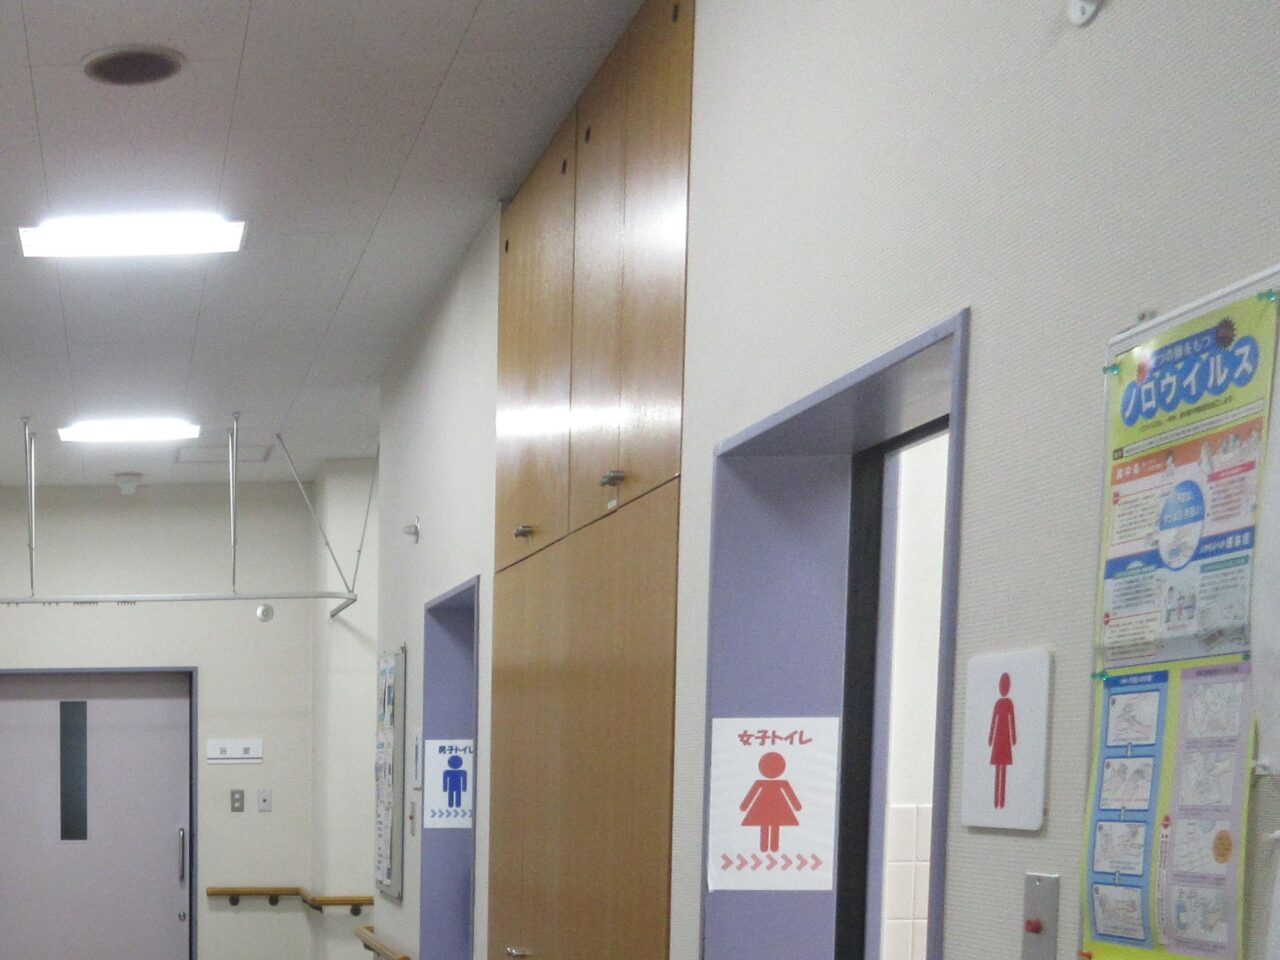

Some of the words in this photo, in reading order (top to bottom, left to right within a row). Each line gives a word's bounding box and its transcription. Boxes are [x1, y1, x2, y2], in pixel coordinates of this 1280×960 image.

[1124, 344, 1252, 419] ノロウイルス
[738, 729, 813, 746] 女子トイレ
[438, 745, 474, 754] 男子トイレ
